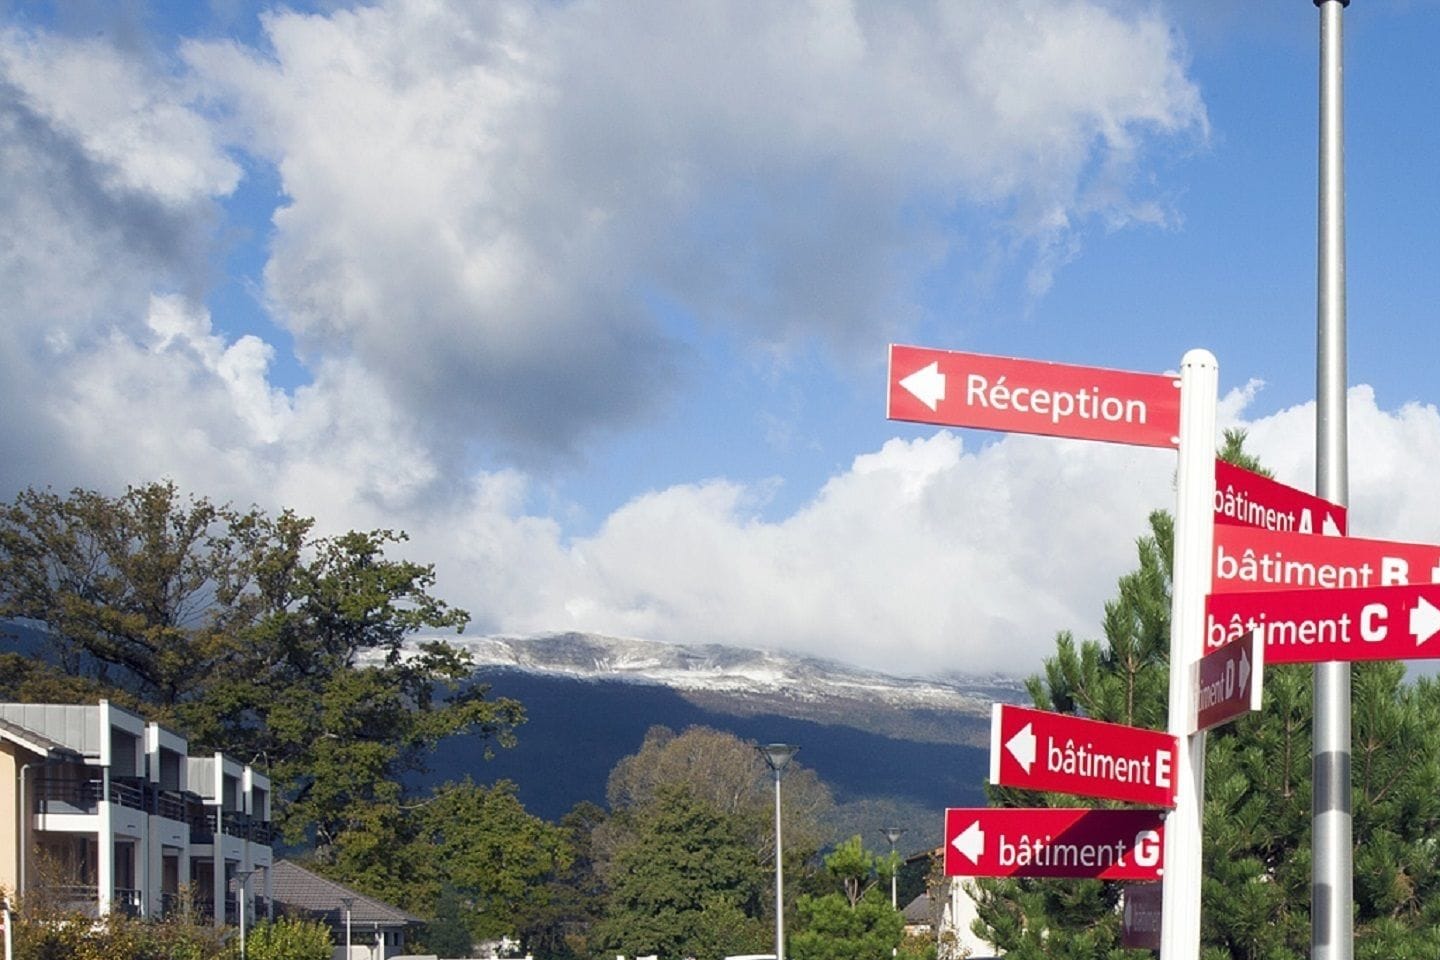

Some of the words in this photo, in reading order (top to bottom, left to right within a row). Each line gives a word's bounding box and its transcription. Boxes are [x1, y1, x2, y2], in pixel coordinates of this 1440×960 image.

[967, 374, 1147, 423] Réception
[1214, 480, 1295, 532] bâtiment
[1298, 508, 1313, 535] A
[1217, 545, 1373, 588] bâtiment
[1360, 603, 1388, 642] C
[1225, 659, 1235, 699] D
[1047, 736, 1150, 785] bâtiment
[1155, 749, 1171, 788] E
[999, 834, 1126, 867] bâtiment
[1133, 830, 1160, 867] G
